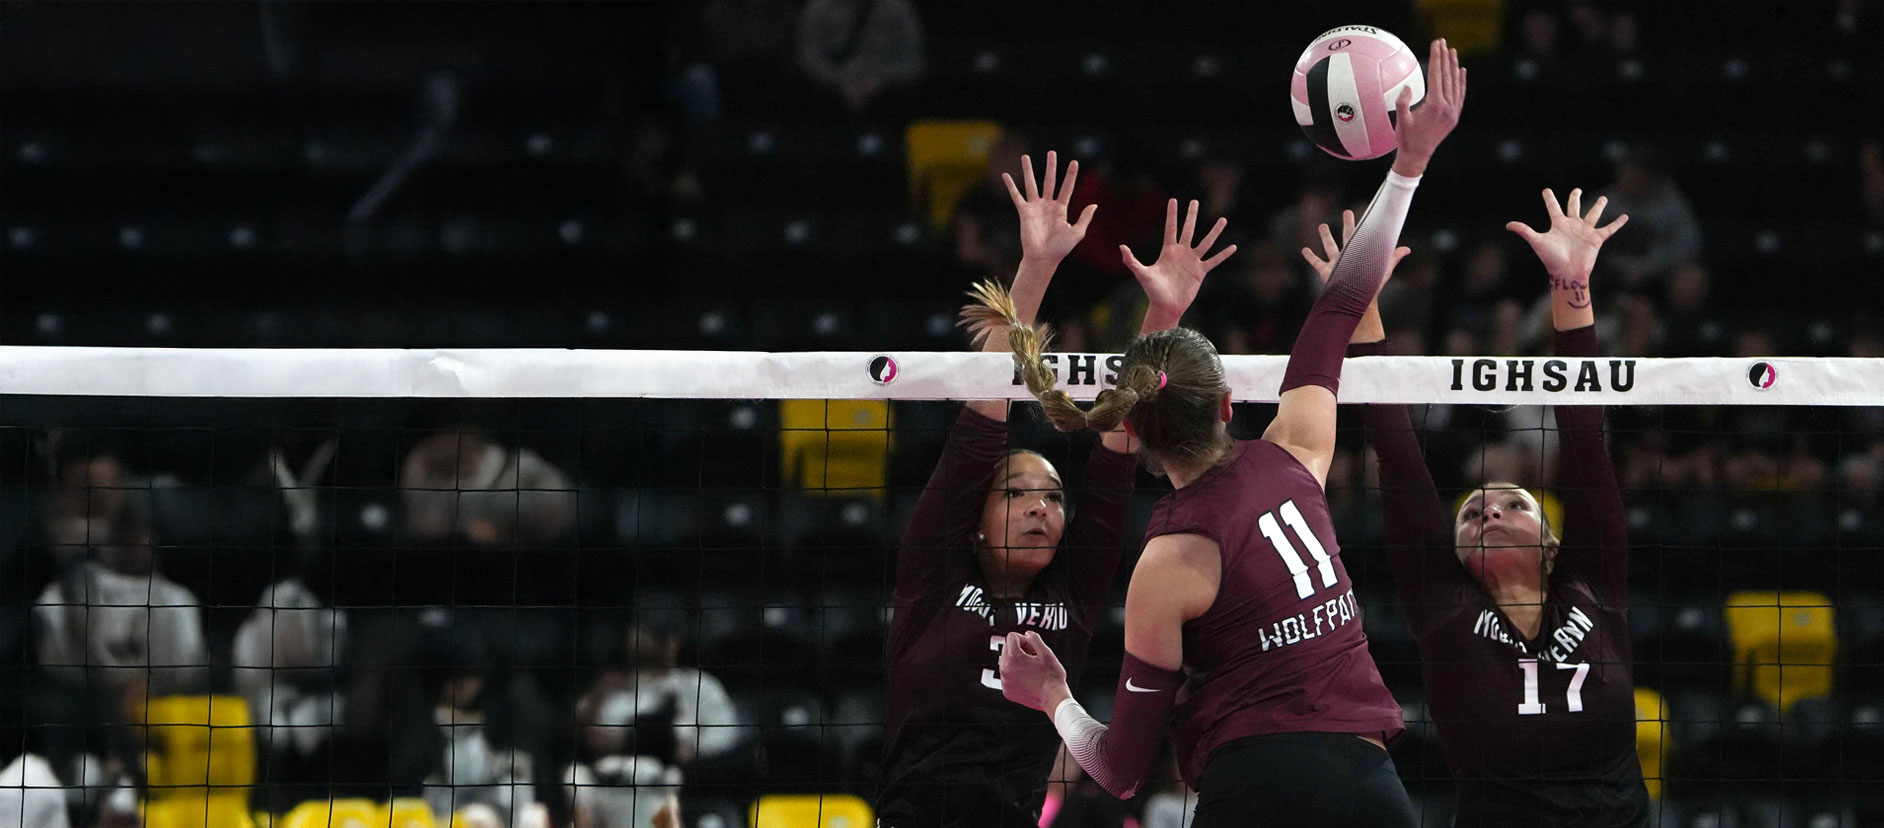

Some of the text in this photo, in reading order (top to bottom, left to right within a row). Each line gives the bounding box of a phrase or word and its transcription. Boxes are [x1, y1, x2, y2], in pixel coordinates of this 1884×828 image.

[1012, 355, 1125, 385] IHS
[1450, 359, 1636, 392] IGHSAU
[1258, 499, 1338, 600] 11
[1258, 588, 1357, 652] WOLFPAC
[1518, 658, 1590, 715] 17
